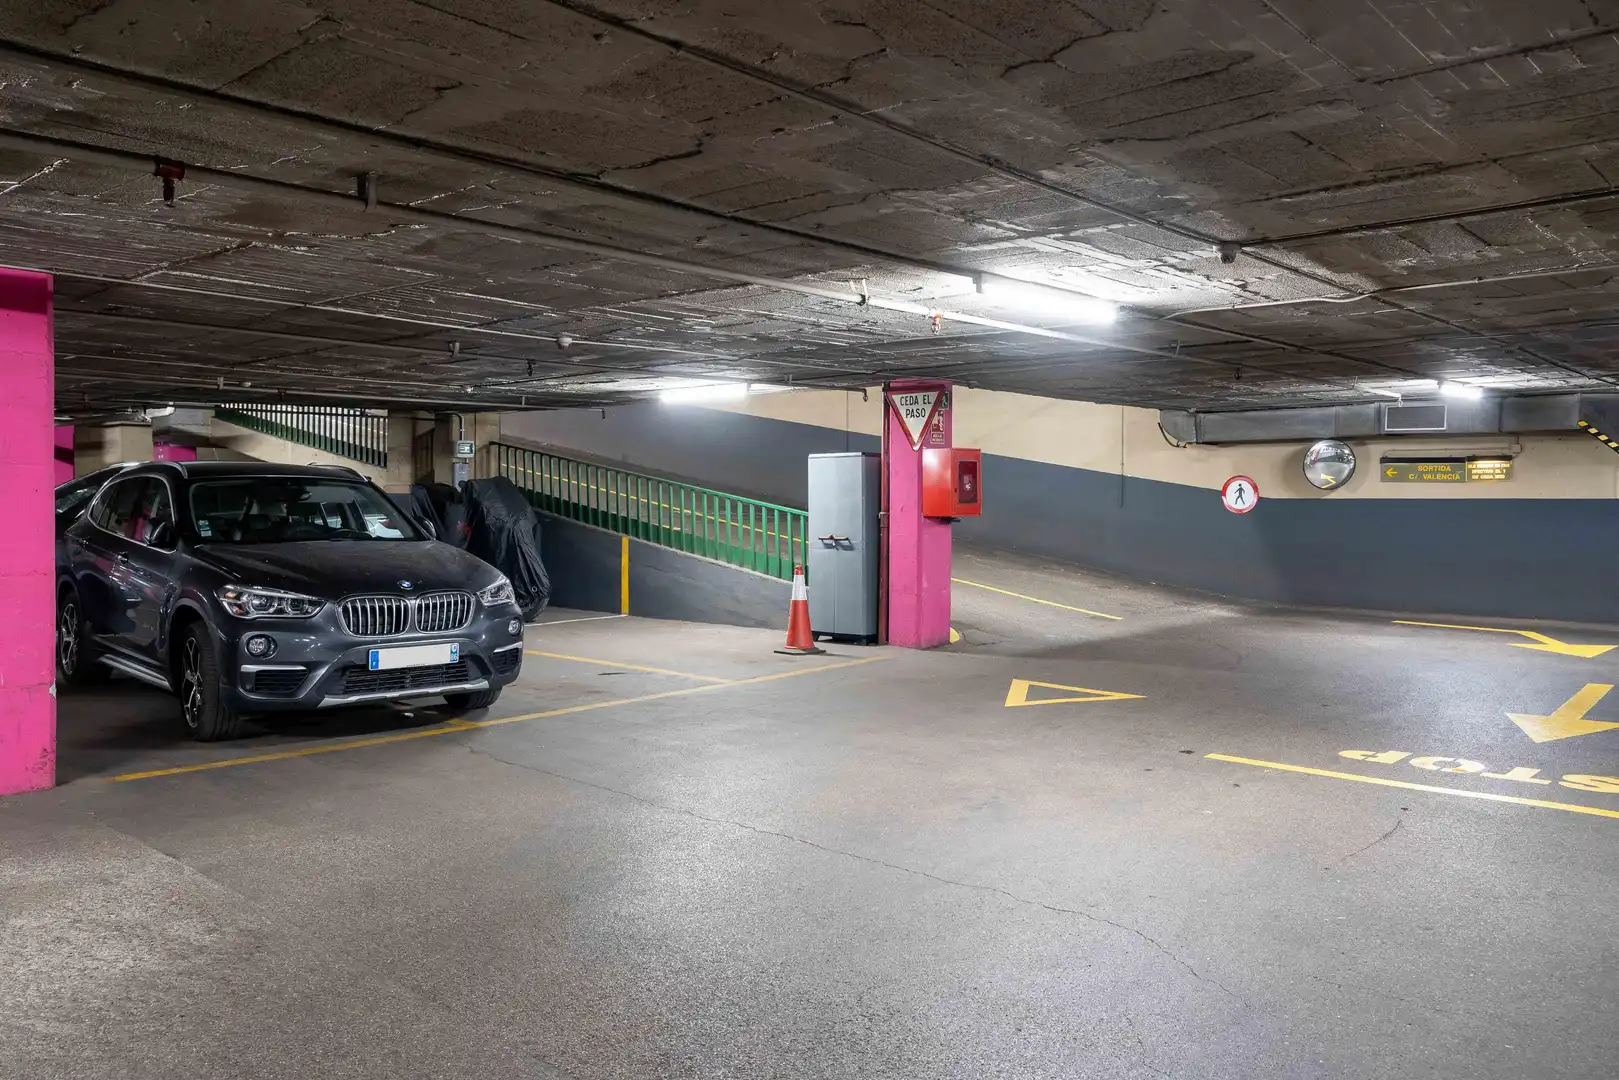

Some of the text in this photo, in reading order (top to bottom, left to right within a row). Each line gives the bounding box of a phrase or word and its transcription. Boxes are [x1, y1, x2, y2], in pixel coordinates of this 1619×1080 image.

[900, 394, 932, 406] CEDA EL
[905, 407, 926, 418] PASO
[1337, 749, 1619, 794] STOP
